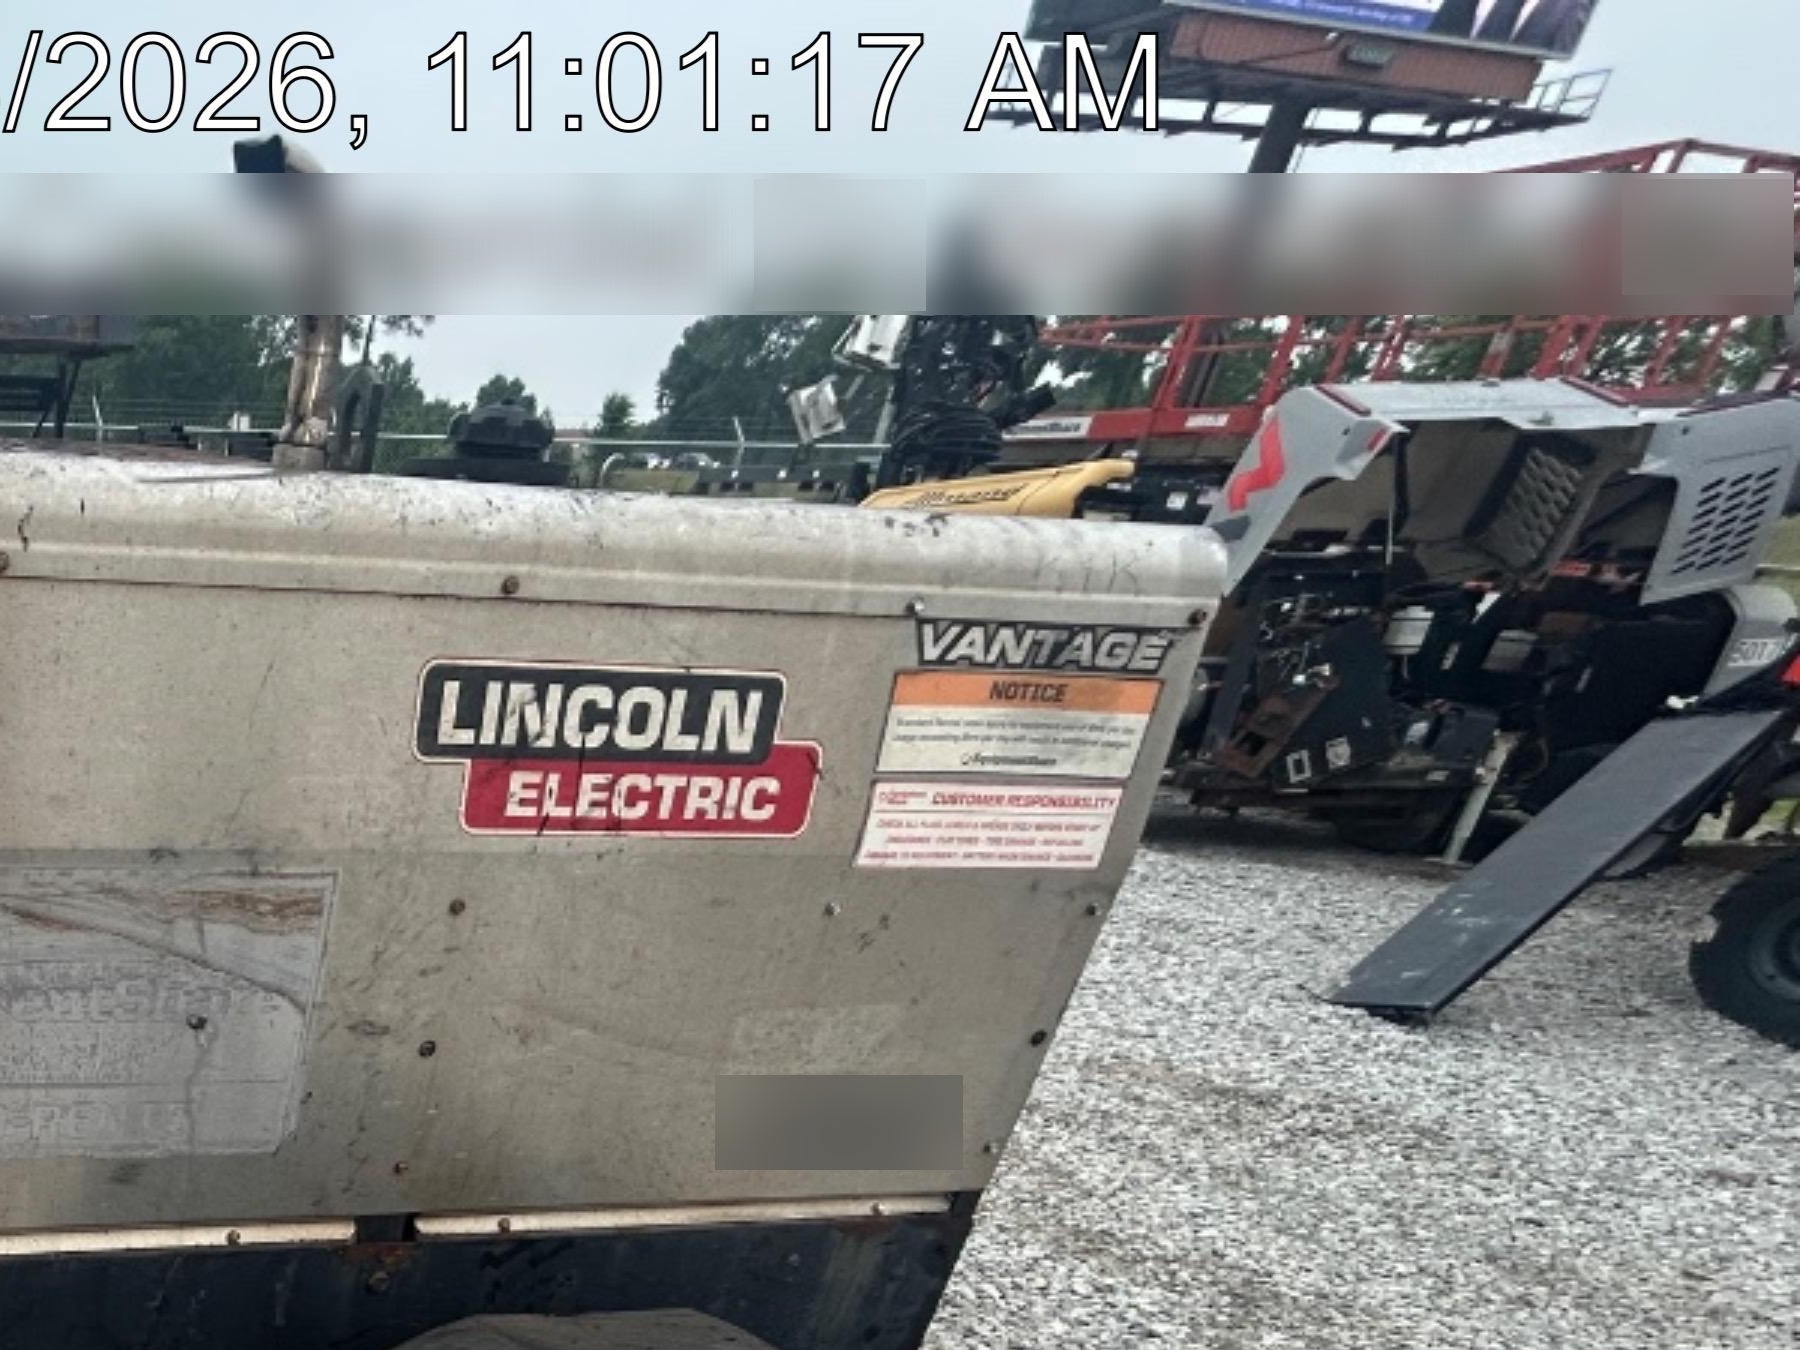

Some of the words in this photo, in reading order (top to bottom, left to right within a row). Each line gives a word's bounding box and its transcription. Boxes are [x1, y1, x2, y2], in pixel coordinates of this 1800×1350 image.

[921, 622, 1170, 671] VANTAGE
[989, 681, 1069, 702] NOTICE
[438, 682, 764, 753] LINCOLN
[505, 771, 780, 822] ELECTRIC
